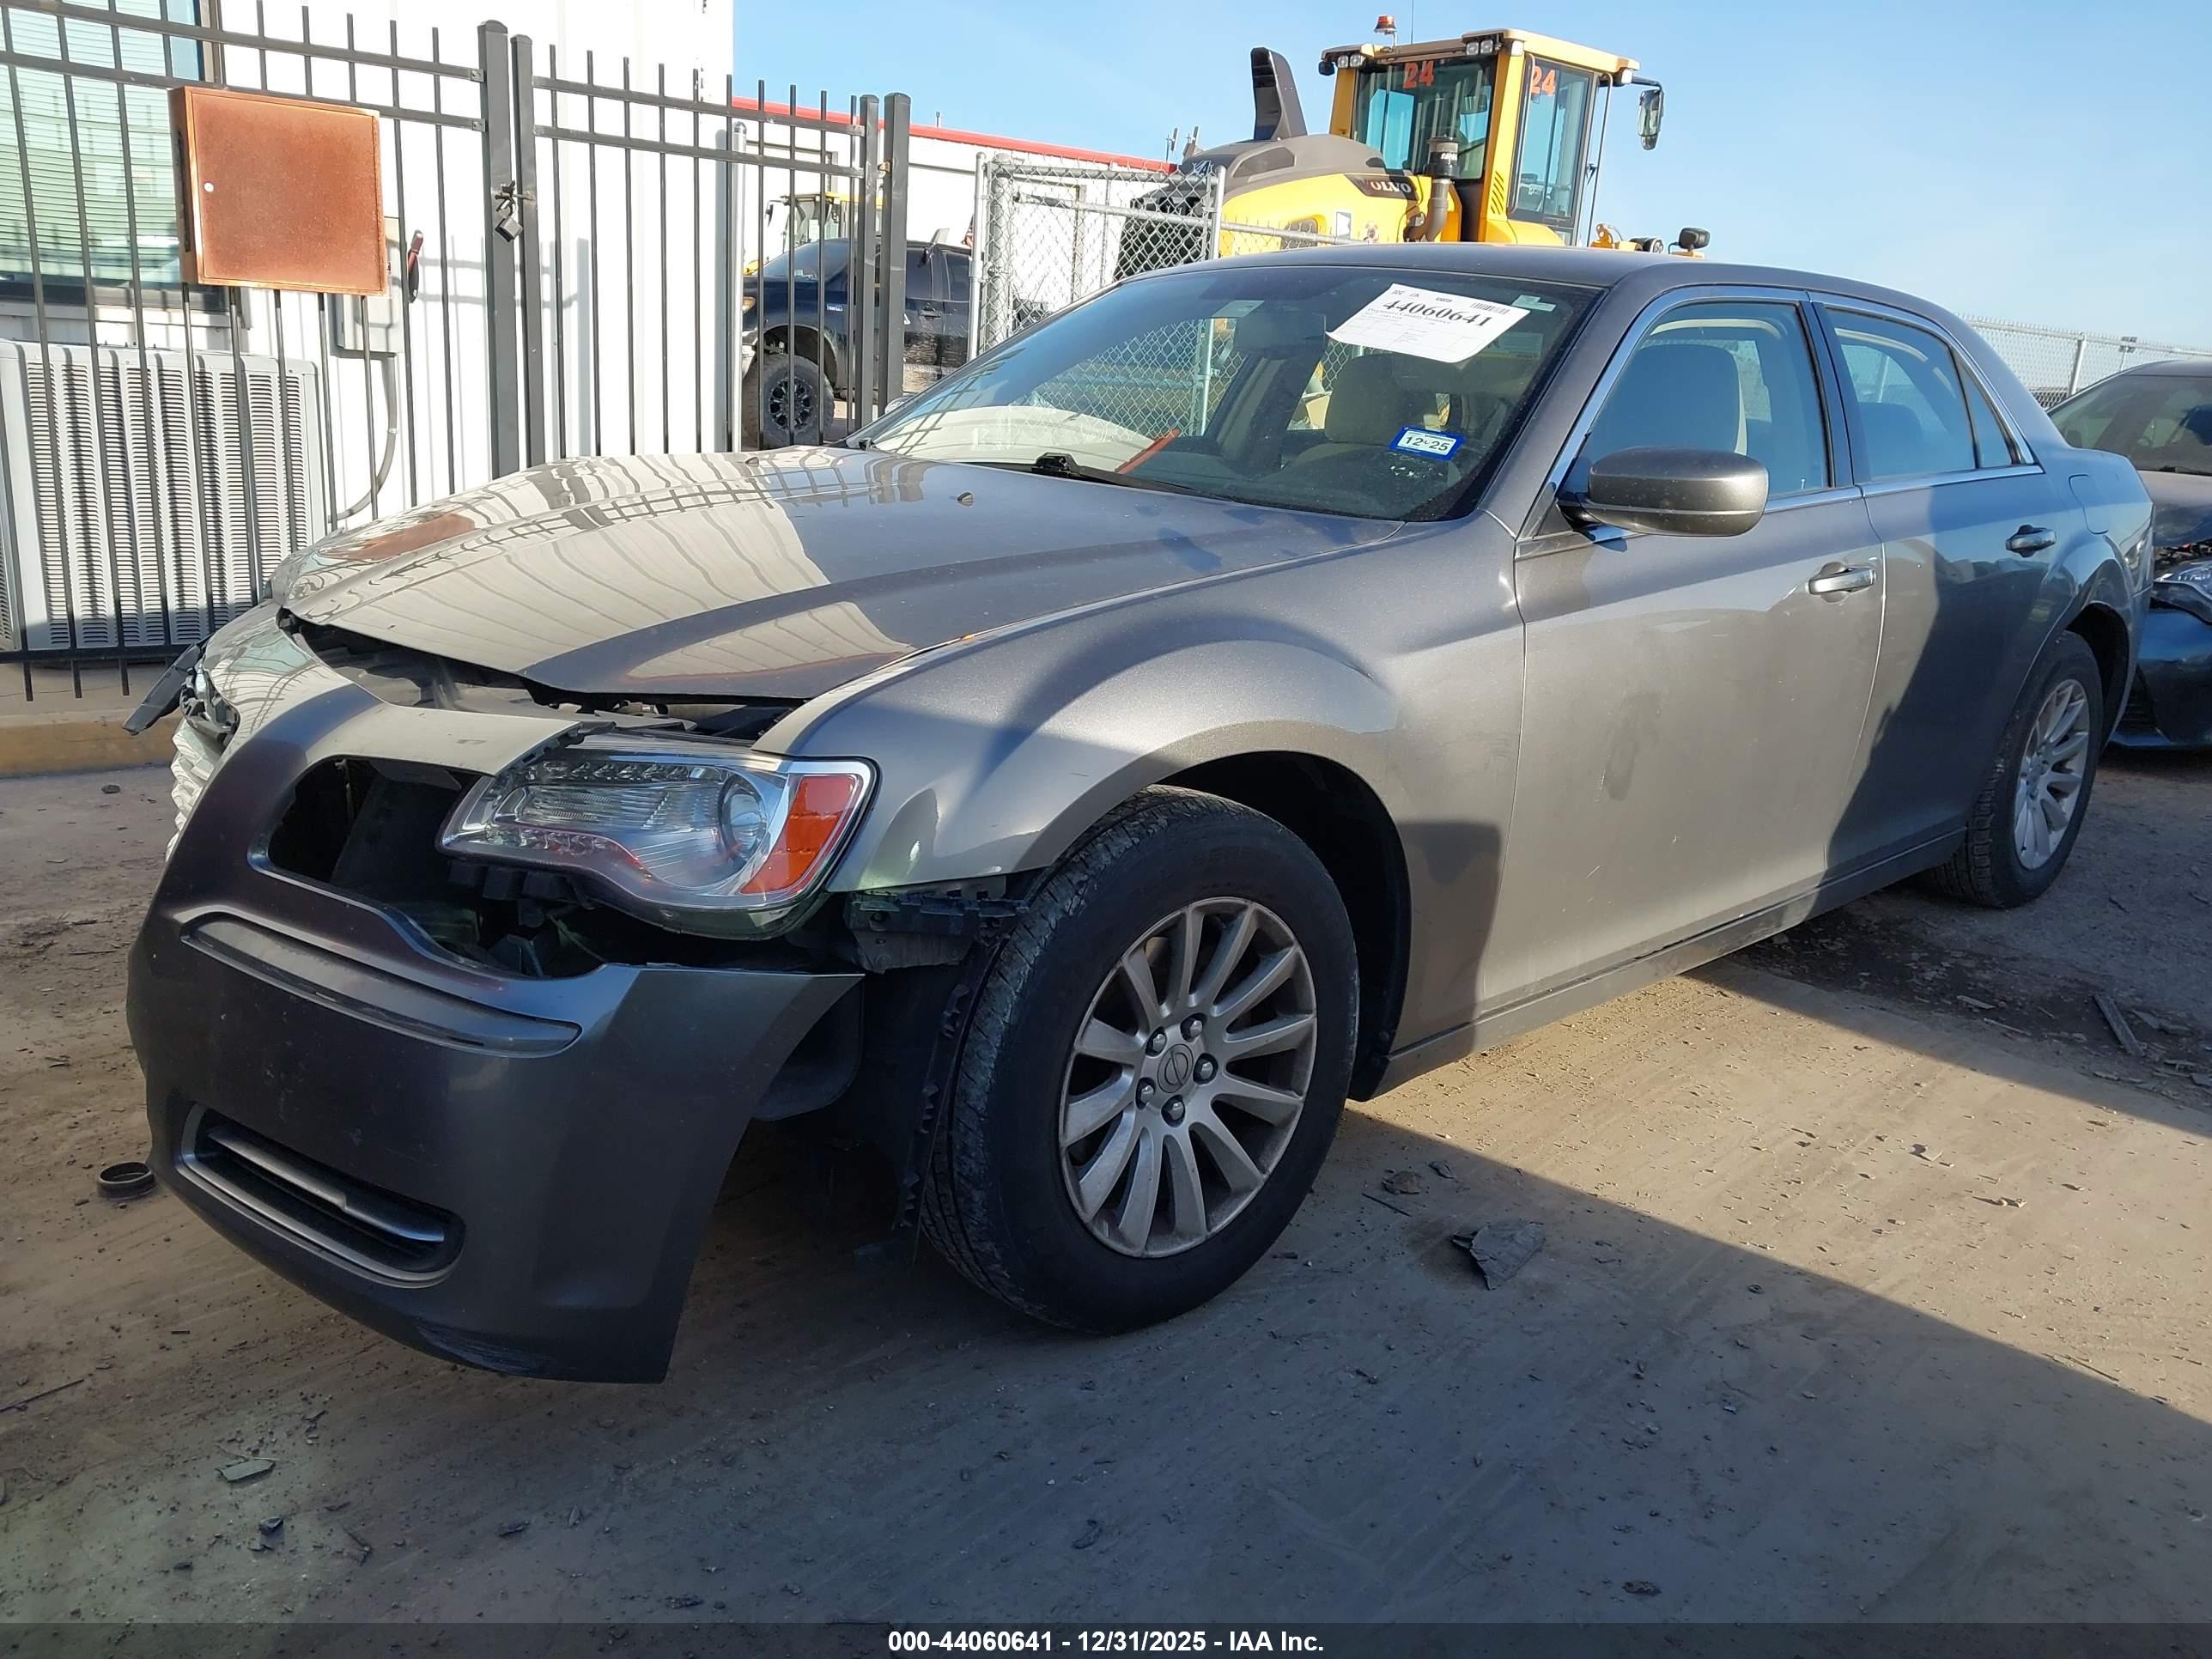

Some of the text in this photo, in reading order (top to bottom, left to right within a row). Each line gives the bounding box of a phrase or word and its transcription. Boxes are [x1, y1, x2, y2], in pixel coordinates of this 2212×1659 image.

[1403, 60, 1435, 88] 24
[1530, 65, 1557, 97] 24
[1382, 300, 1493, 327] 44060641
